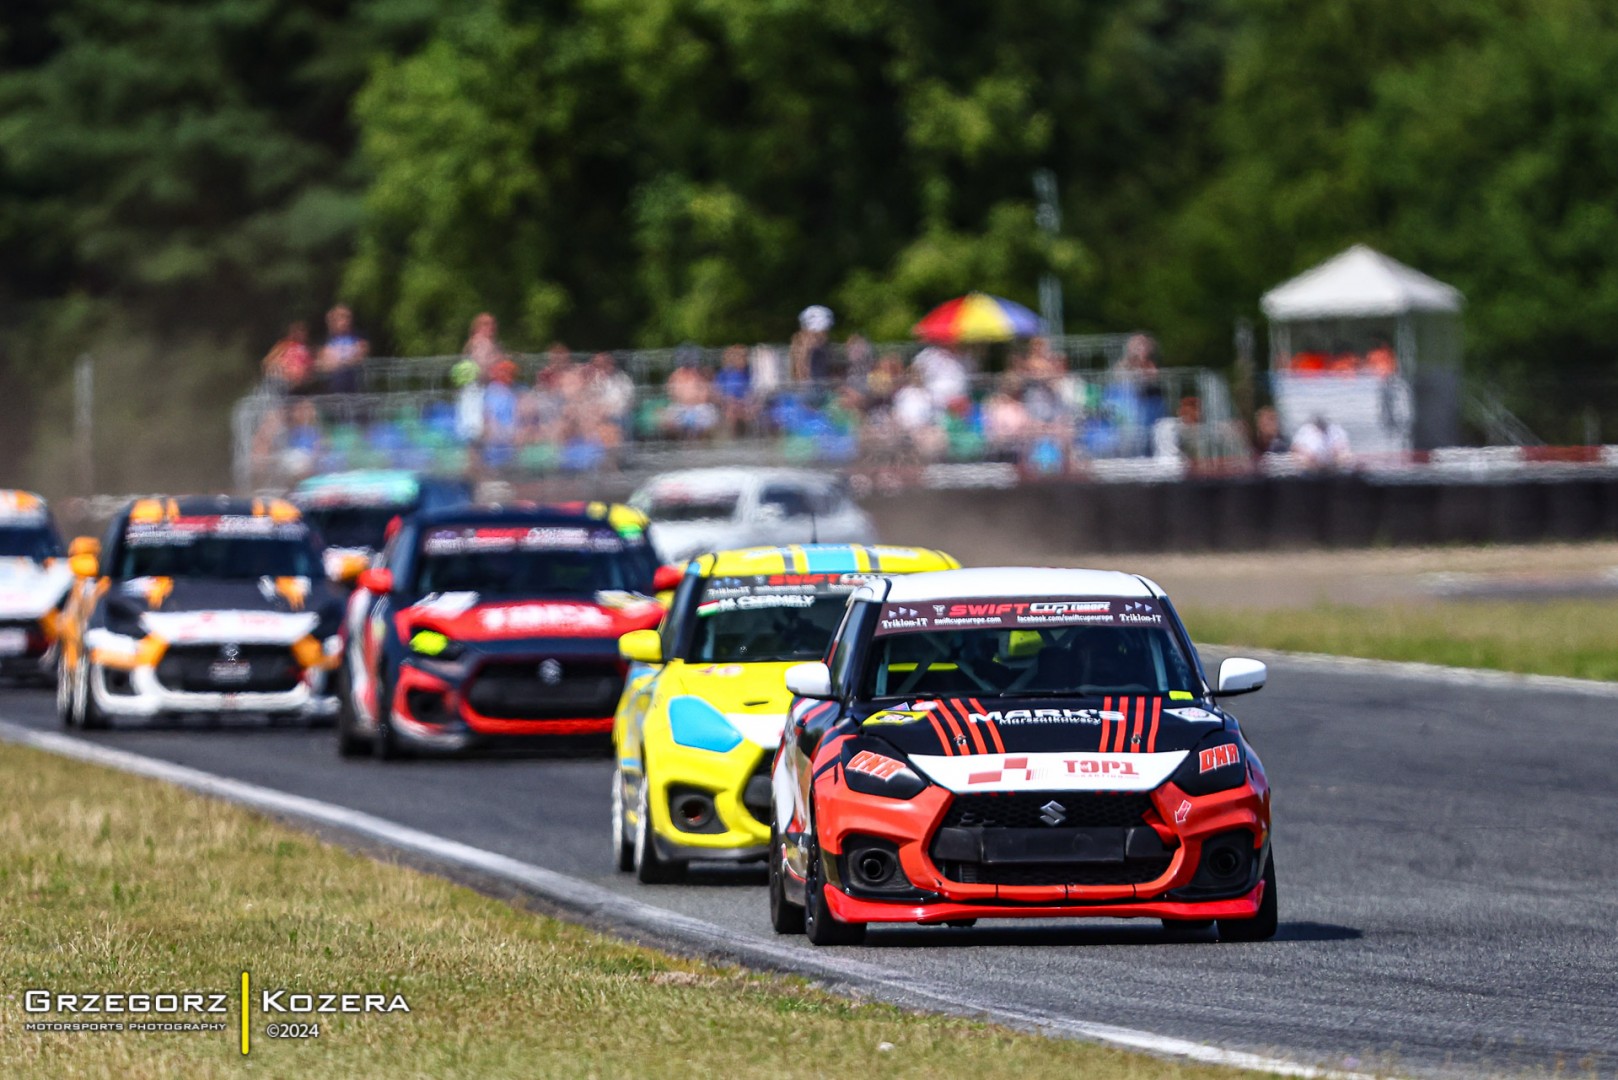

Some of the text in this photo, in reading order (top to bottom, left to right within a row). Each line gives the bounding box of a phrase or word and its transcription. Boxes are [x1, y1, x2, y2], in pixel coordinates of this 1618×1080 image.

[949, 603, 1030, 616] SWIFT
[1029, 602, 1069, 615] CUP
[968, 709, 1125, 723] MARK'S
